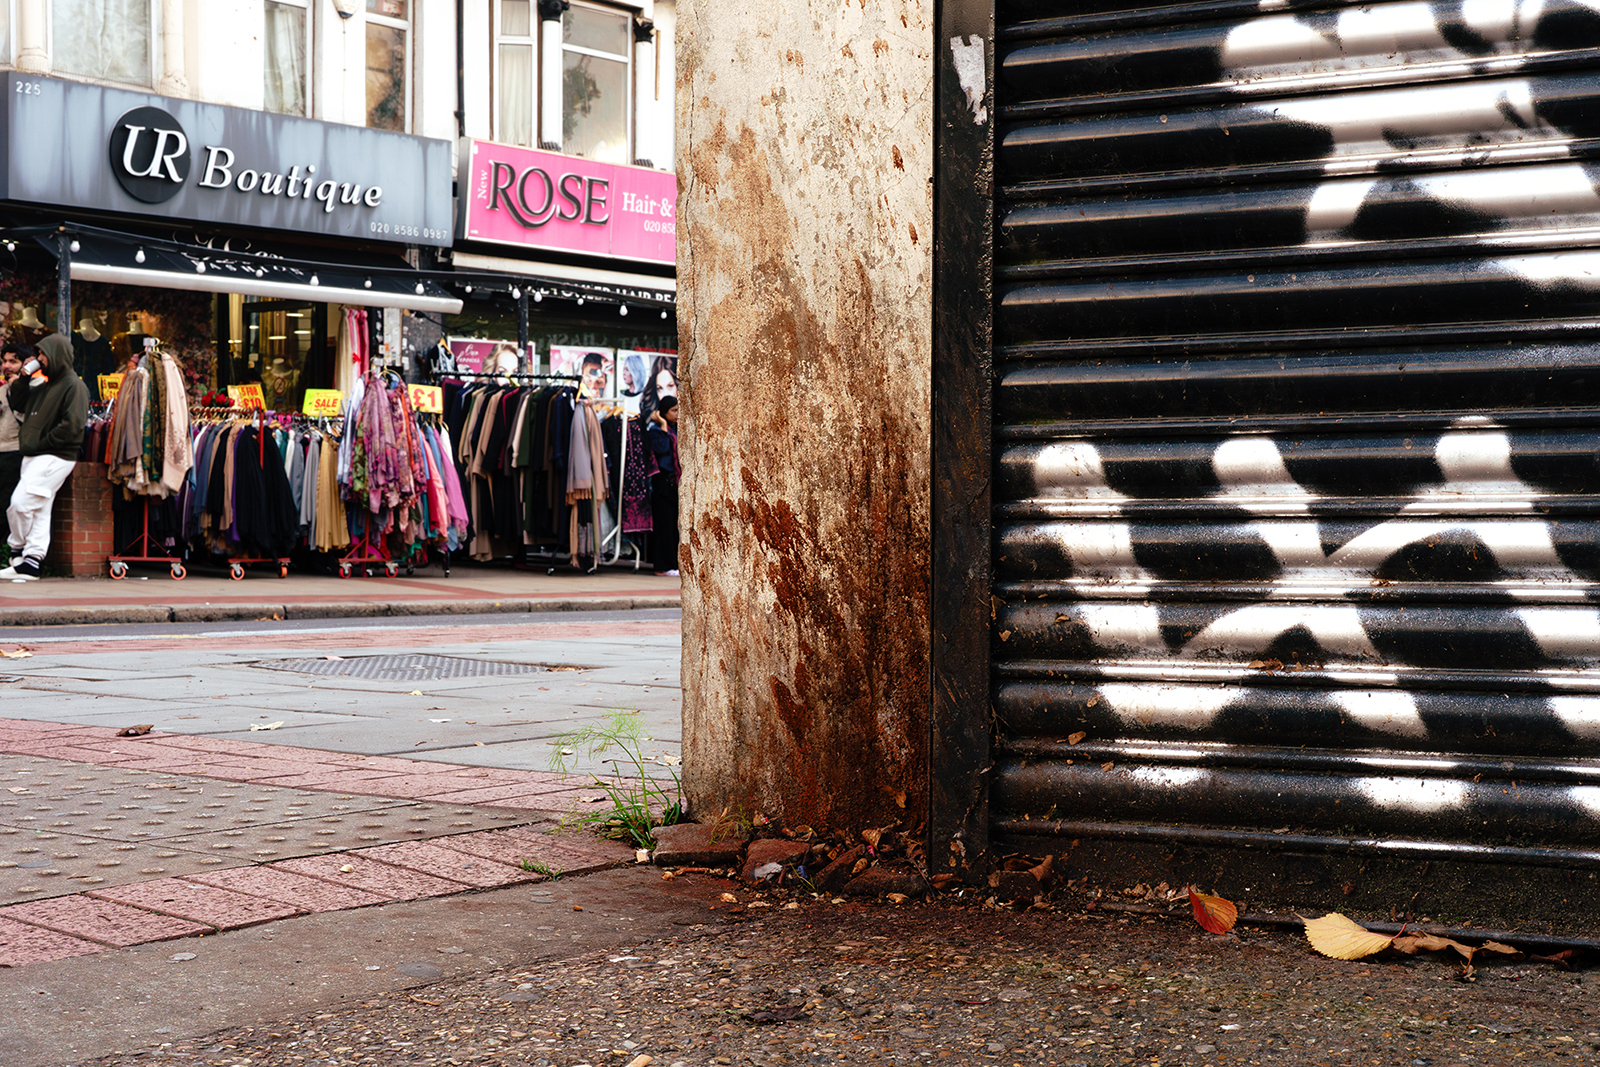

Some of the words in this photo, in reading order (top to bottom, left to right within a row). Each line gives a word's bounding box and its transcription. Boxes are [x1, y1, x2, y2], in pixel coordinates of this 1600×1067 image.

[15, 81, 41, 96] 225
[123, 124, 187, 183] UR
[198, 145, 383, 213] Boutique
[477, 170, 489, 200] New
[486, 159, 610, 230] ROSE
[622, 192, 657, 215] Hair
[660, 198, 673, 218] &
[370, 221, 390, 234] 020
[394, 224, 419, 237] 8586
[423, 228, 448, 240] 0987
[643, 219, 661, 233] 020
[314, 398, 338, 408] SALE
[413, 388, 436, 408] £1
